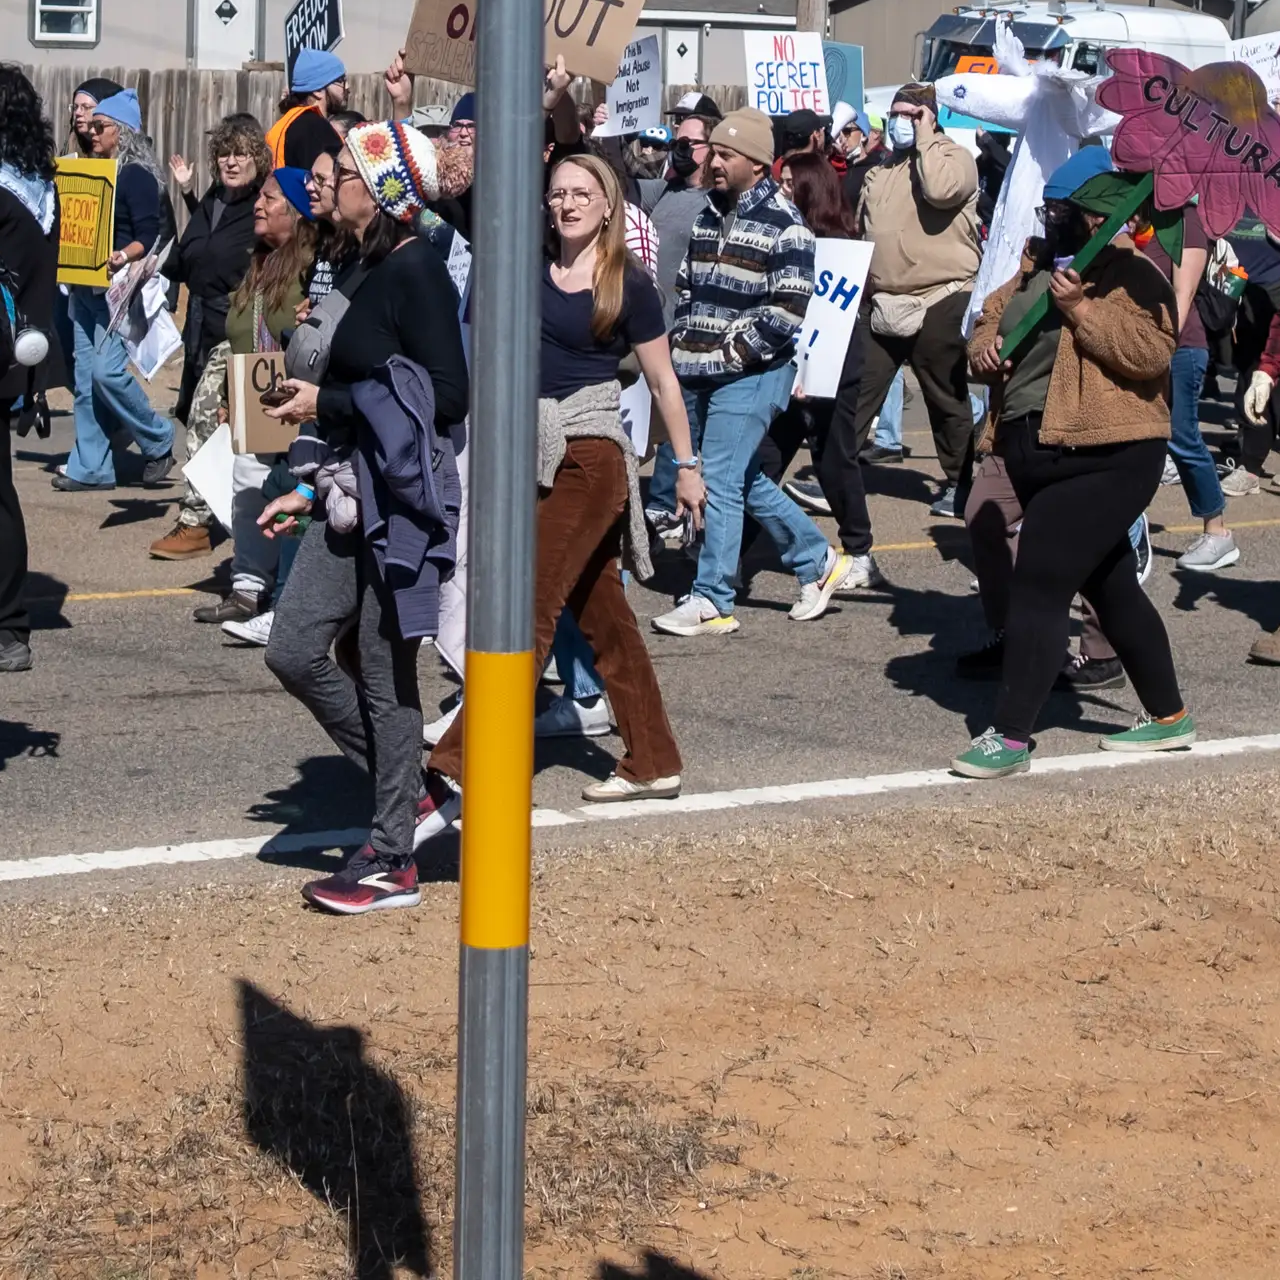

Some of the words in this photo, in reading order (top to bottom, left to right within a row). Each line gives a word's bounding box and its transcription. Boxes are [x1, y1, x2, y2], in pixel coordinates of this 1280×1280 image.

[773, 35, 795, 62] NO
[632, 60, 651, 75] Abuse
[754, 61, 820, 89] SECRET
[626, 79, 640, 93] Not
[616, 96, 650, 113] Immigration
[757, 89, 824, 114] POLICE
[621, 115, 638, 129] Policy
[76, 224, 95, 247] KIDS
[815, 270, 860, 311] SH
